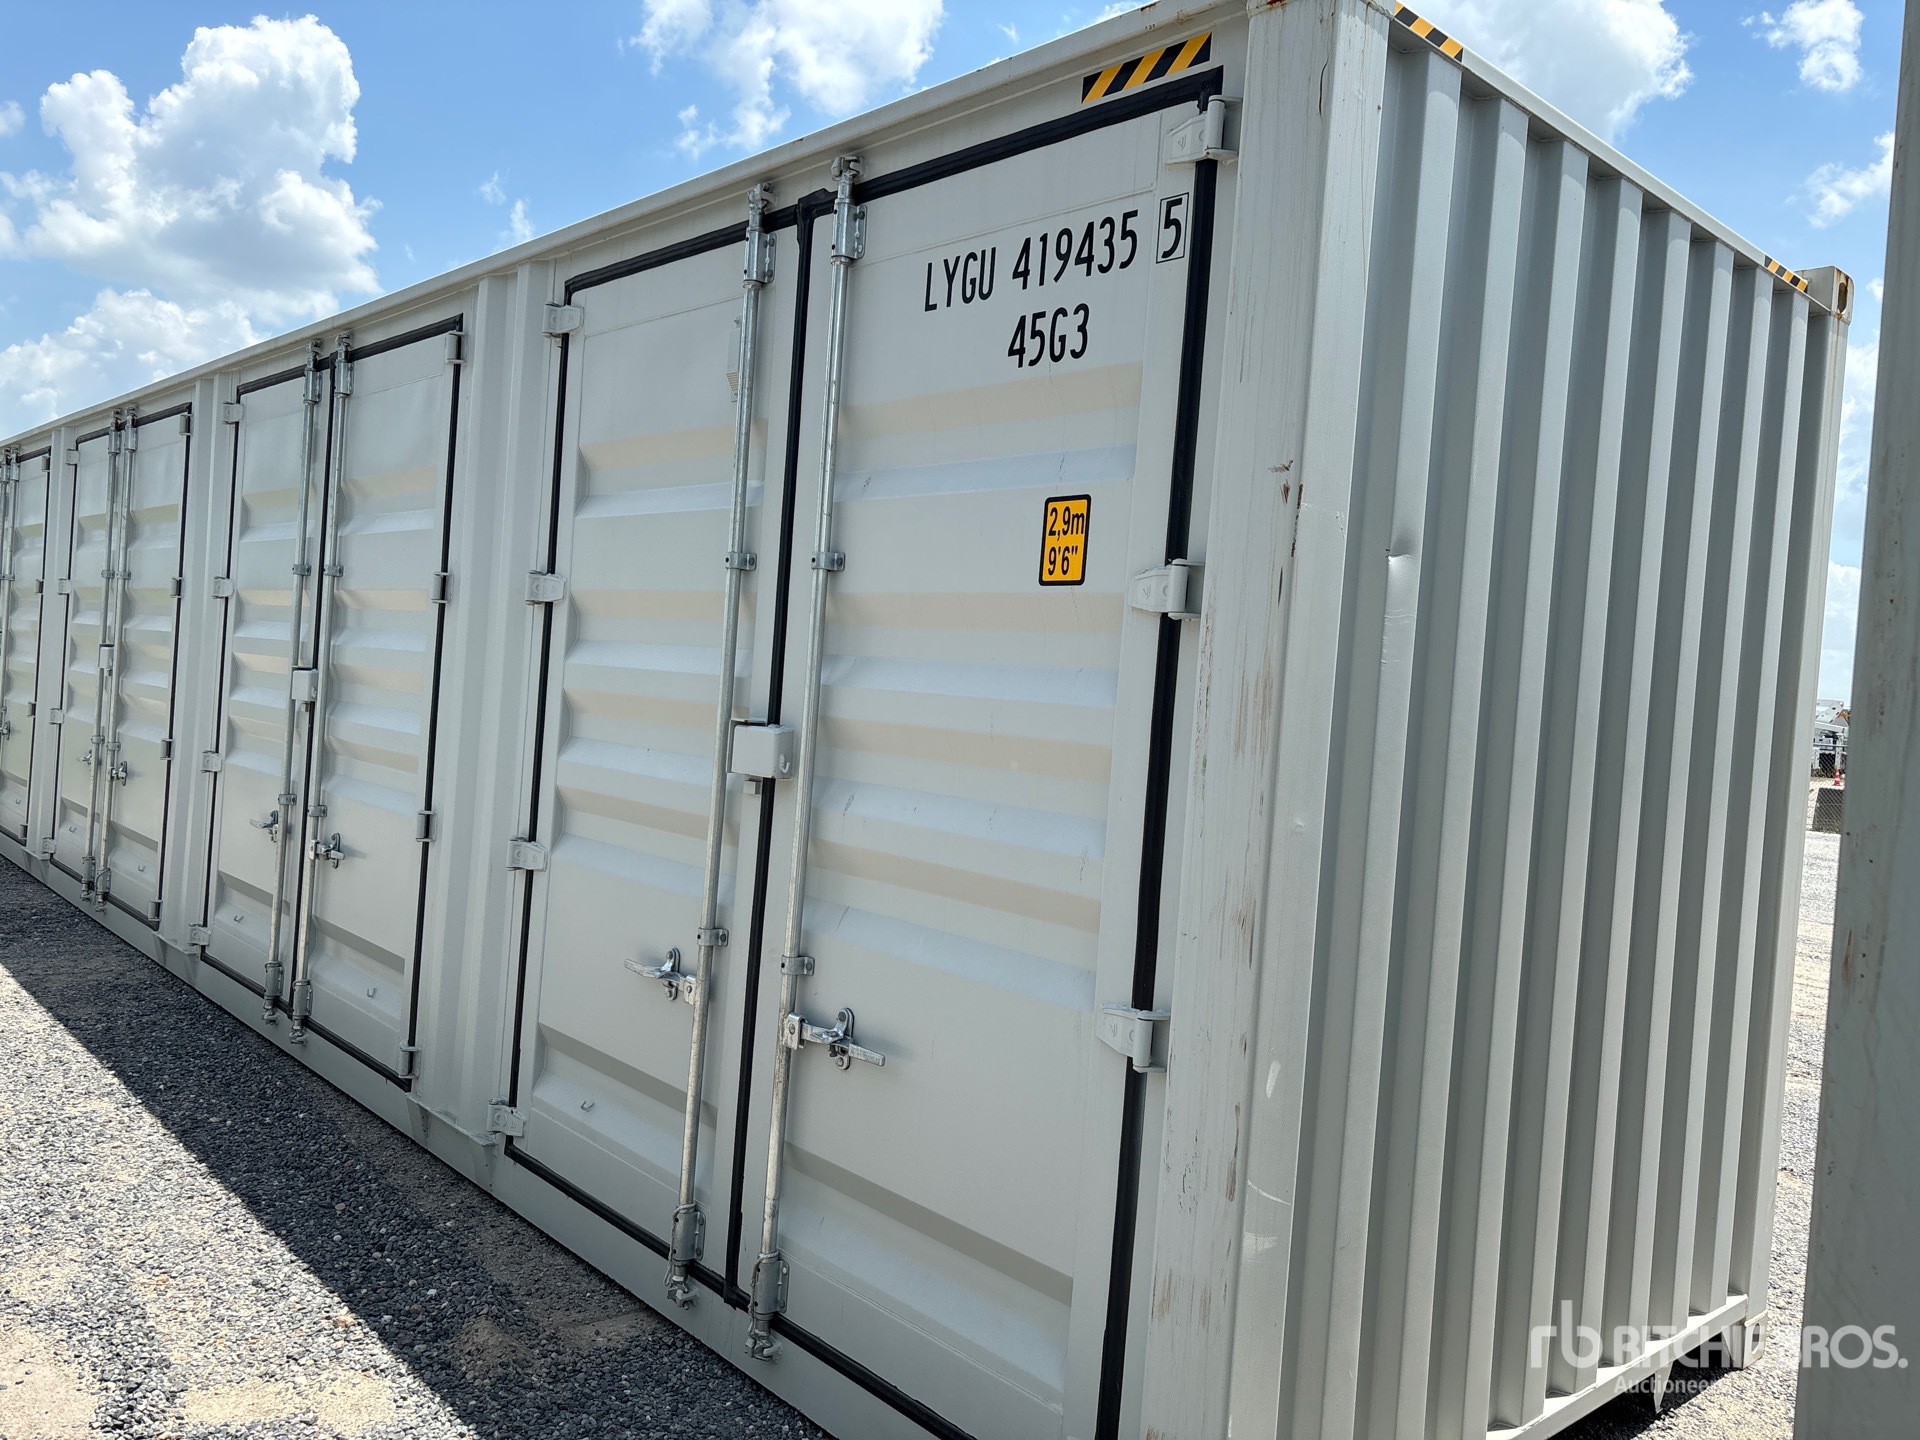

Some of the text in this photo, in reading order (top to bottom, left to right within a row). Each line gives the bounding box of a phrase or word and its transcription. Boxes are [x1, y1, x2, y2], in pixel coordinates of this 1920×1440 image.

[925, 198, 1183, 312] LYGU 419435 5
[1008, 303, 1090, 368] 45G3
[1048, 506, 1085, 541] 2,9m
[1048, 545, 1078, 576] 9'6"
